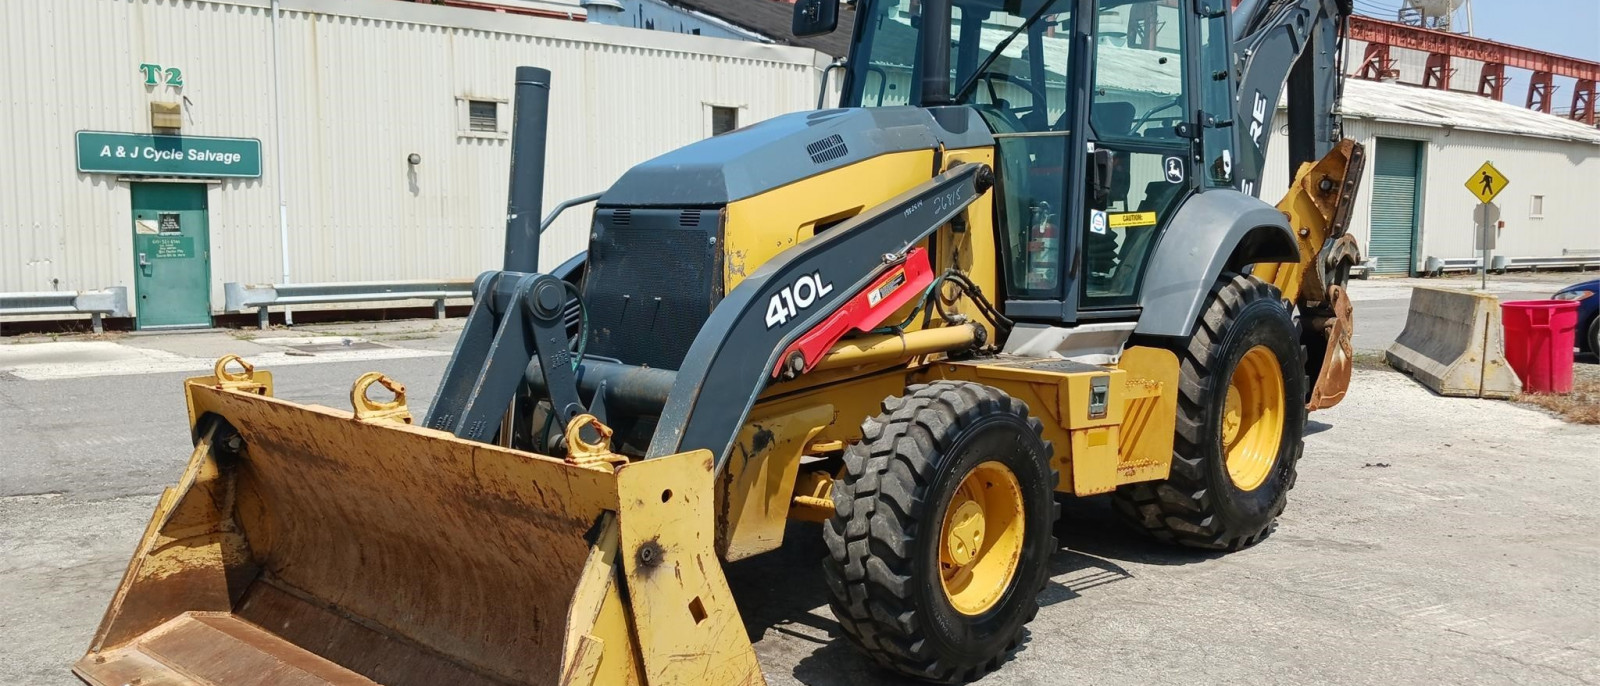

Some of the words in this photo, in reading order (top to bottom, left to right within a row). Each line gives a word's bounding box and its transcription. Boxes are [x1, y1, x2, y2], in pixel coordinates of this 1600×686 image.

[139, 63, 184, 87] T2
[100, 145, 111, 157] A
[116, 146, 126, 158] &
[130, 146, 139, 158] J
[143, 147, 184, 162] Cycle
[187, 149, 241, 165] Salvage
[765, 272, 833, 328] 410L
